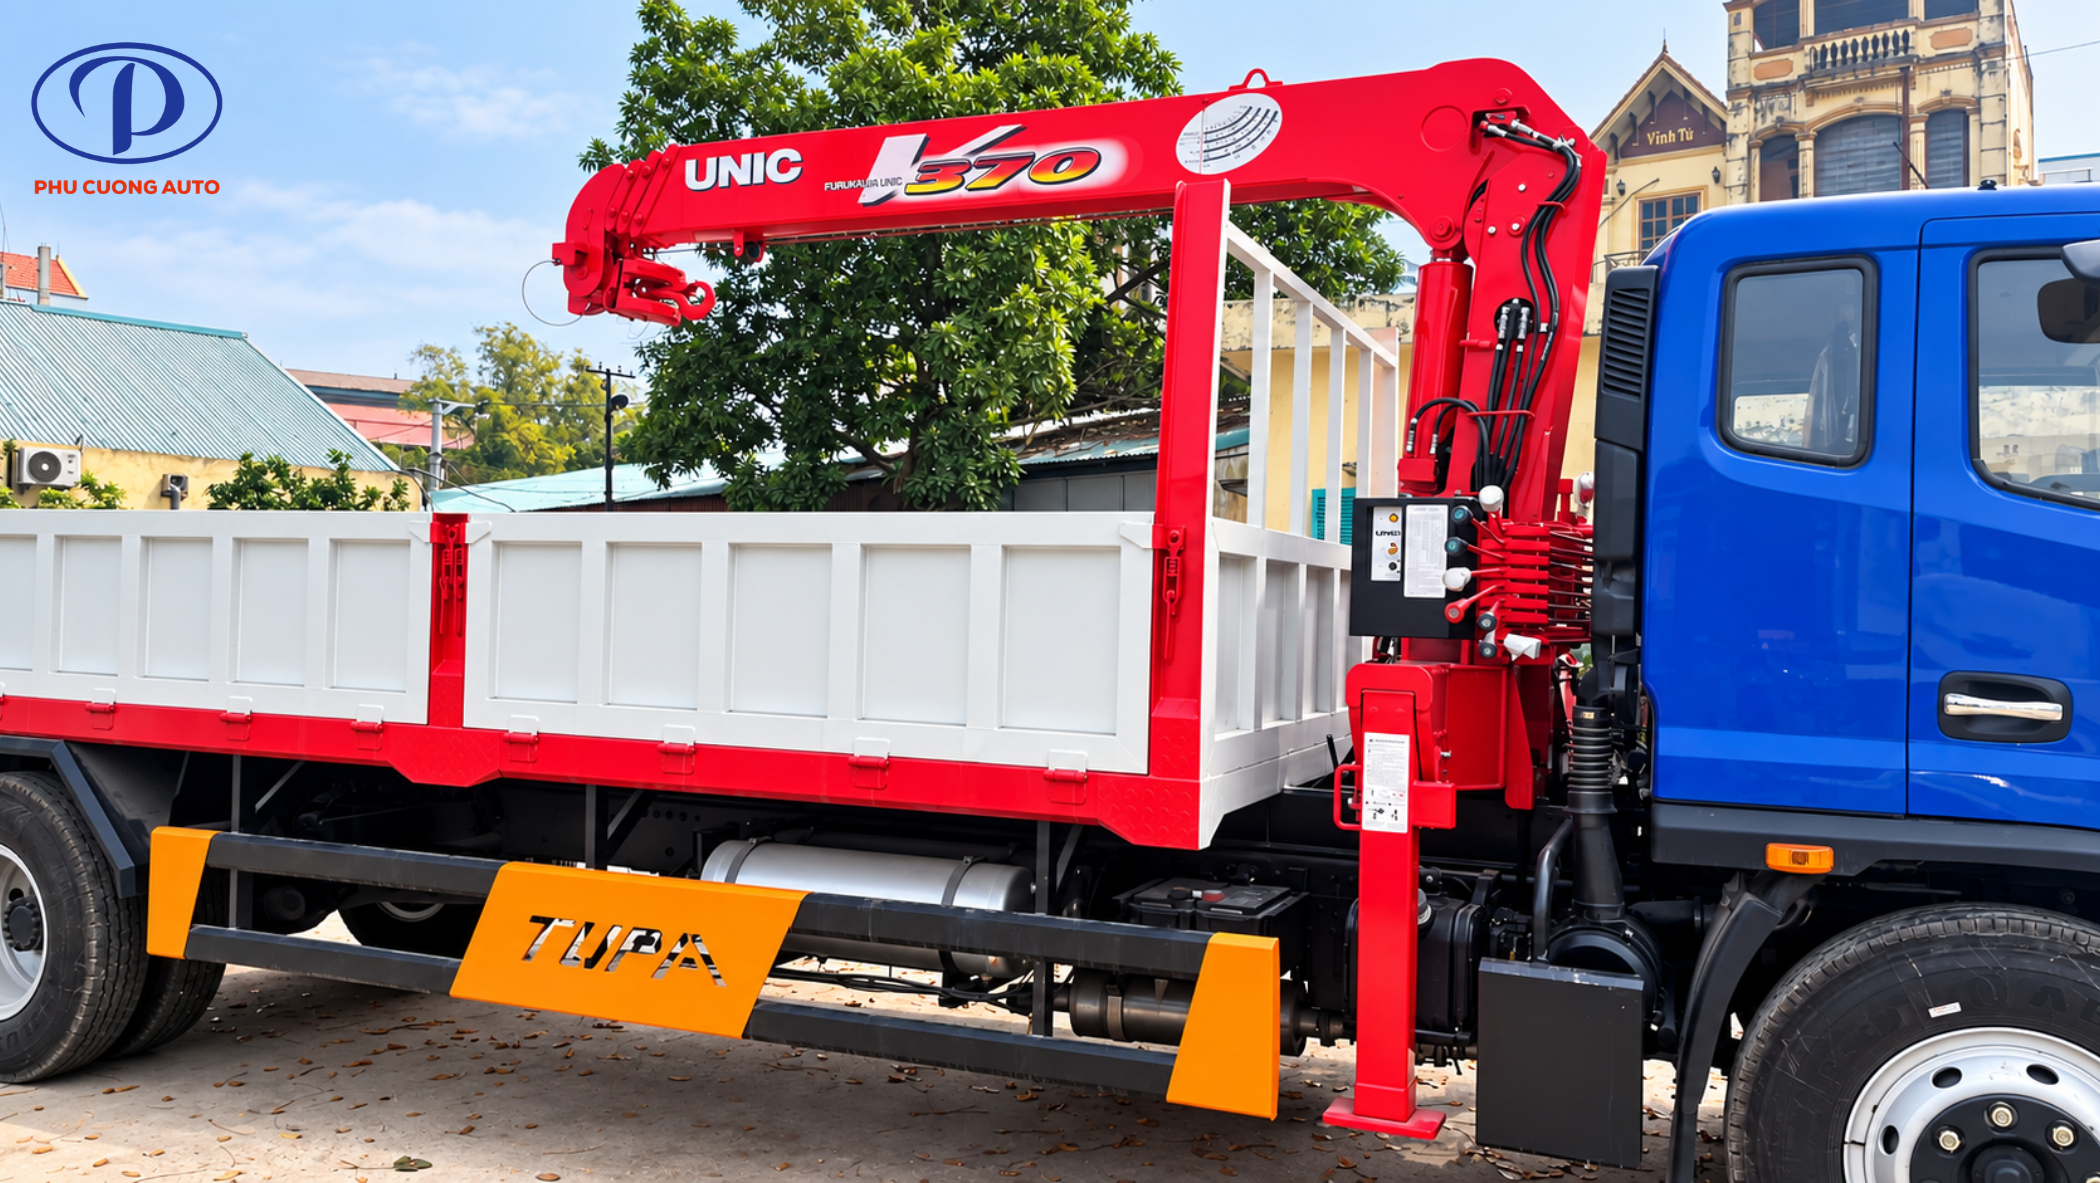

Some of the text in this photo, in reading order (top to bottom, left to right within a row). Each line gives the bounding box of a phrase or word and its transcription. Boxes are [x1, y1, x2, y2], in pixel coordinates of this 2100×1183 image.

[685, 148, 803, 192] UNIC
[879, 176, 903, 187] UNIC
[521, 914, 727, 988] TUPA
